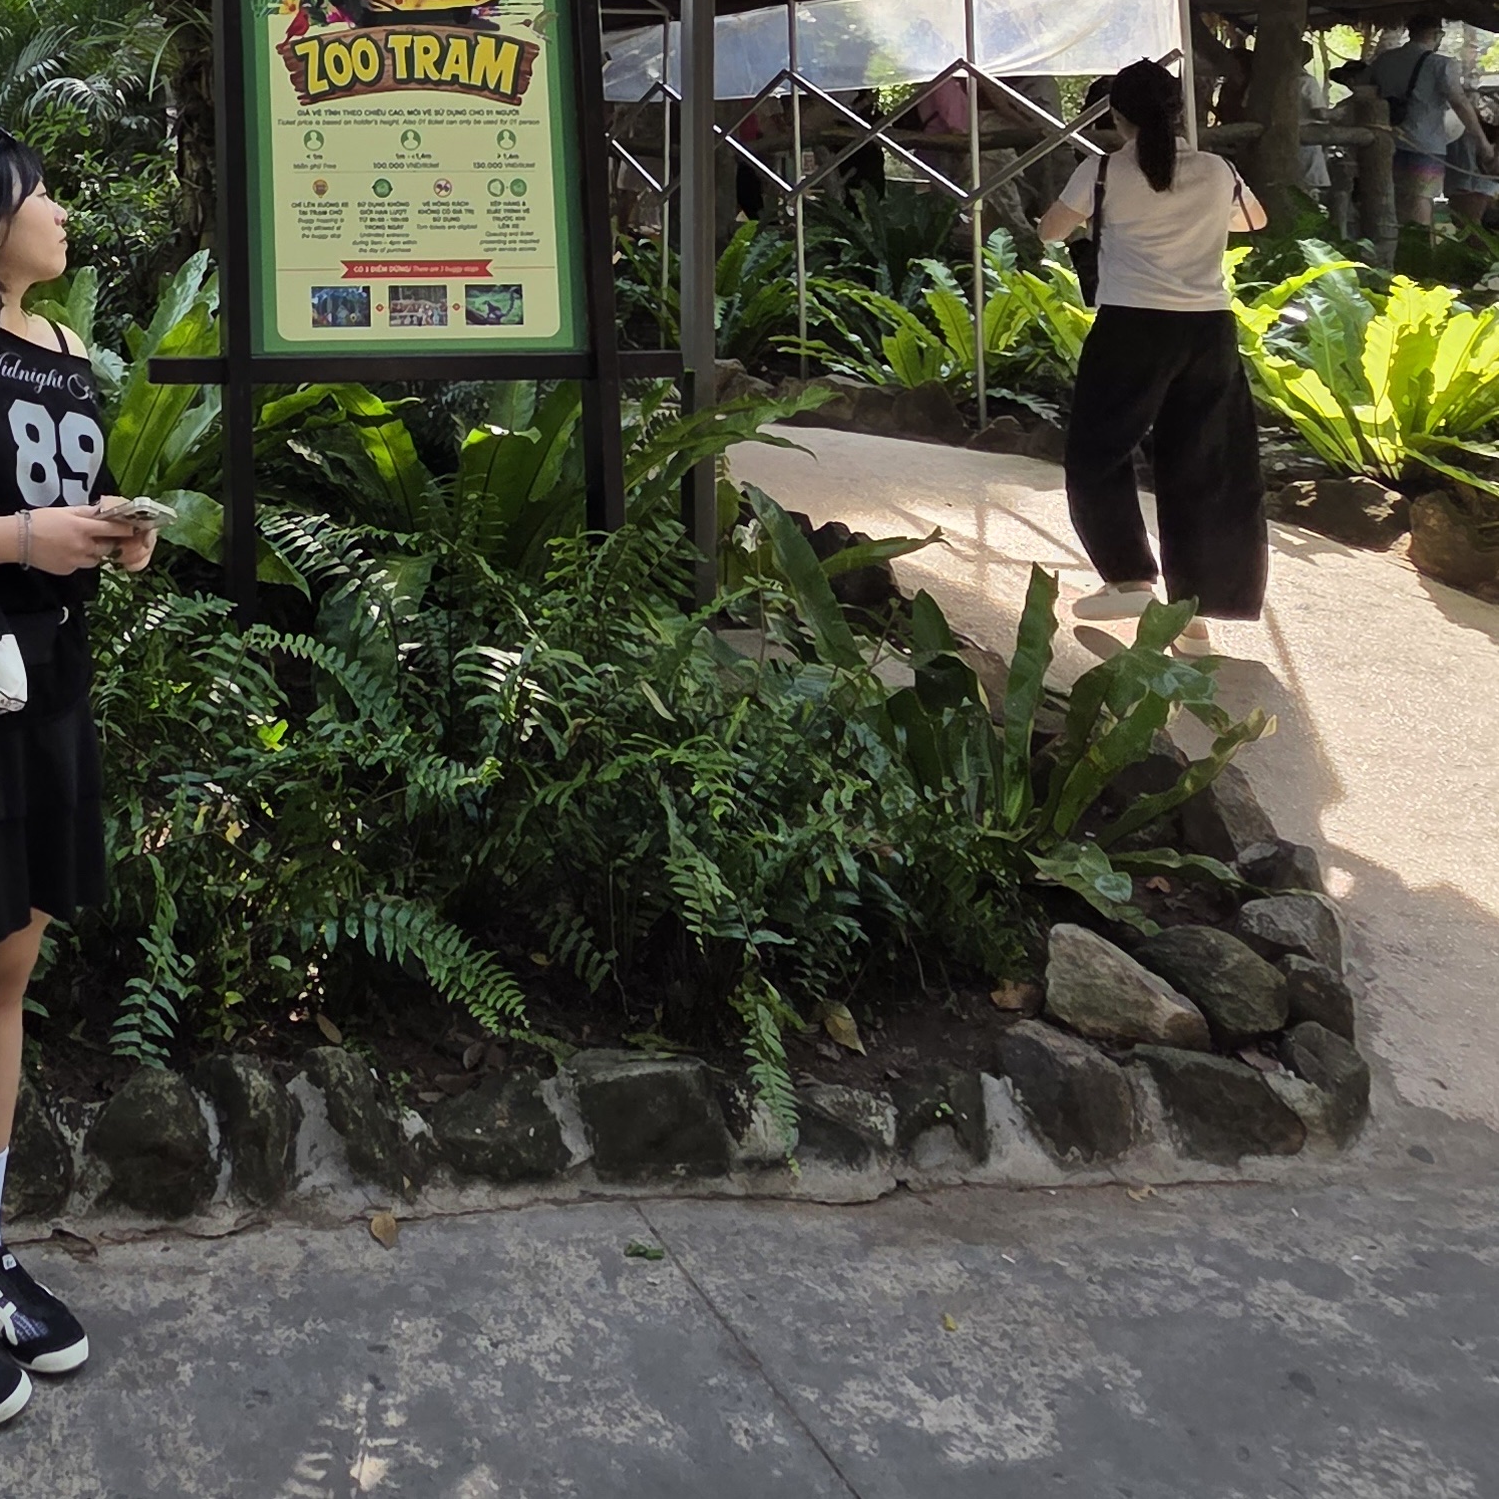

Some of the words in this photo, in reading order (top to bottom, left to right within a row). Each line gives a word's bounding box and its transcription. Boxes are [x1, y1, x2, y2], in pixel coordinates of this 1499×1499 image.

[294, 37, 380, 96] ZOO
[387, 34, 520, 95] TRAM
[8, 399, 104, 507] 89
